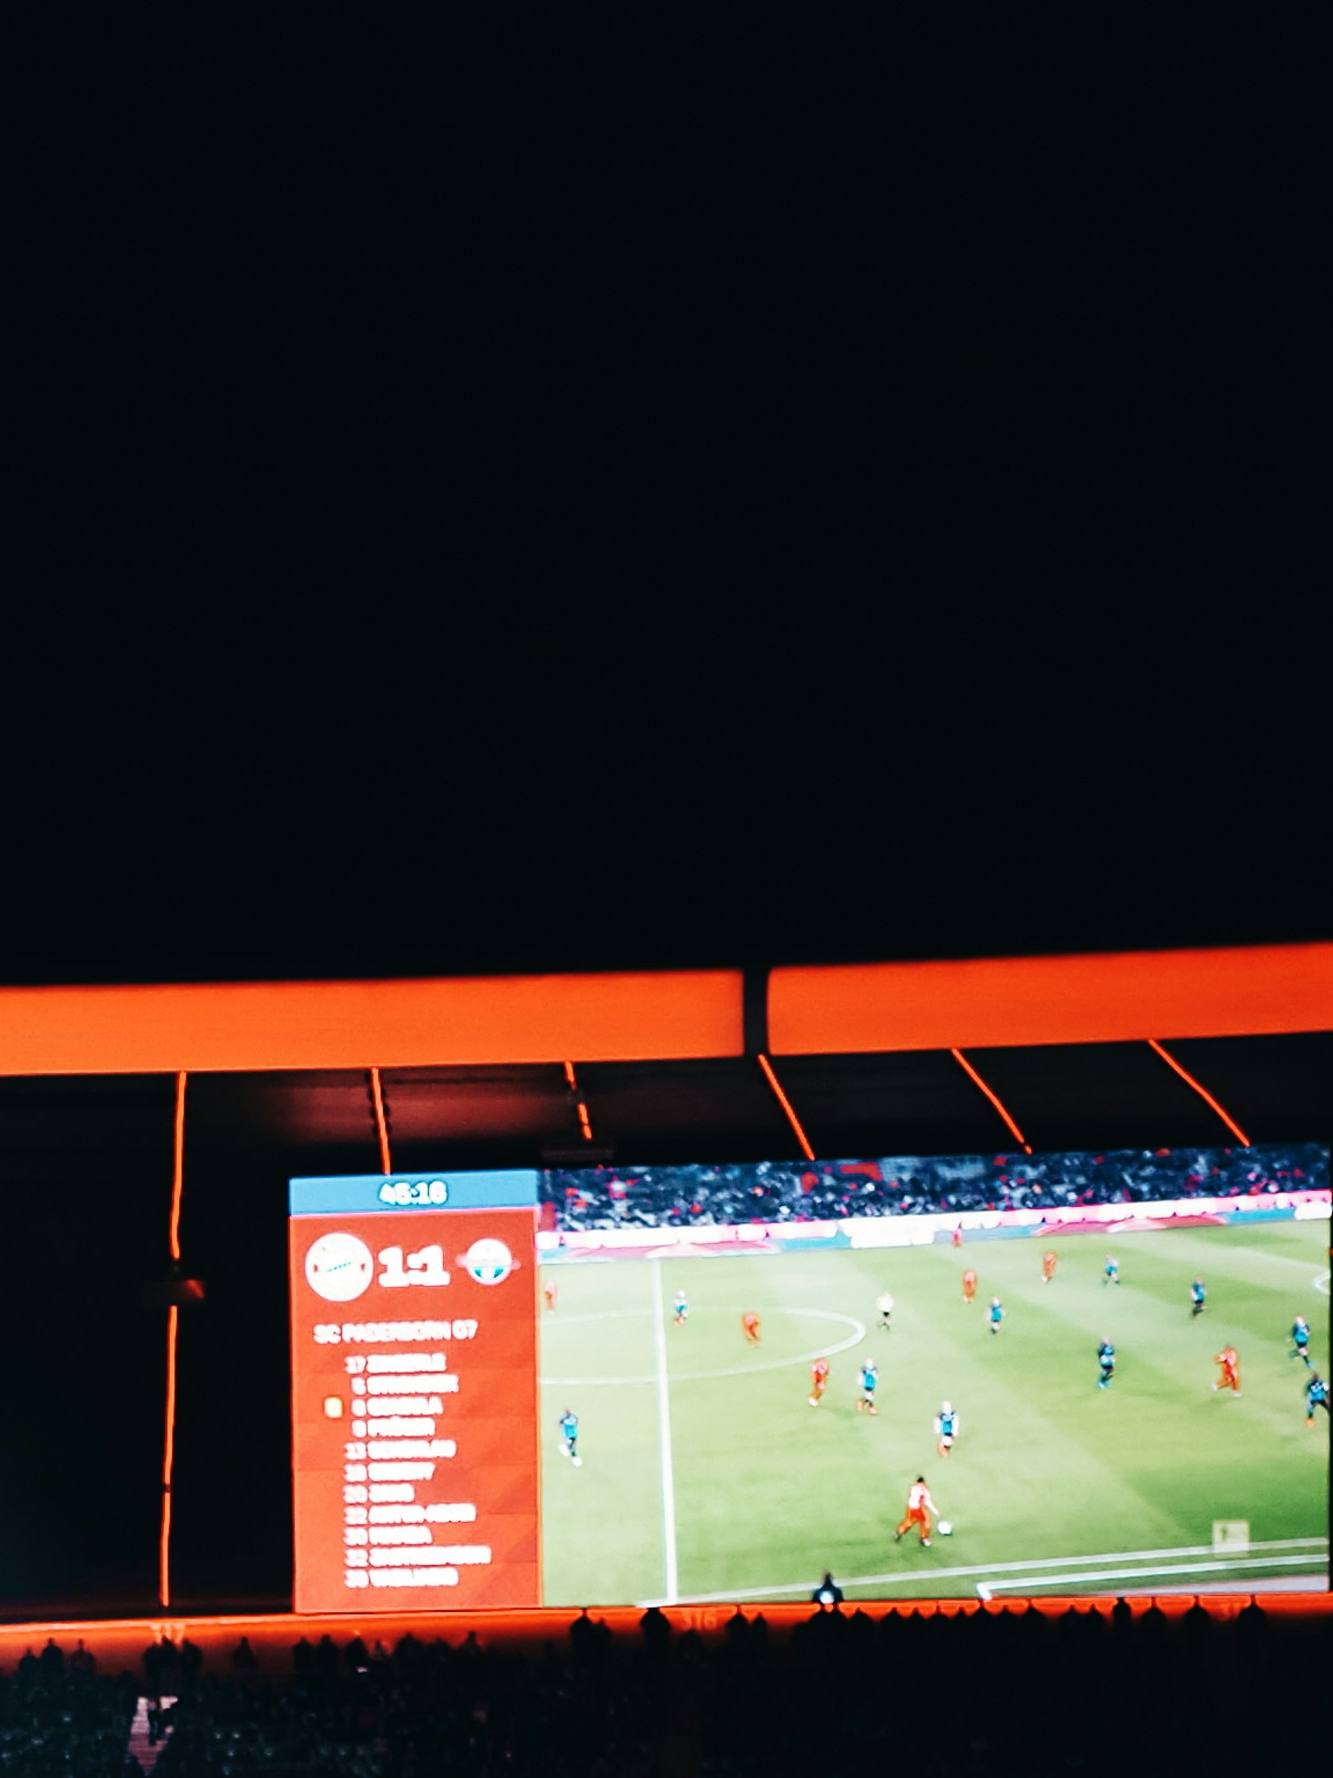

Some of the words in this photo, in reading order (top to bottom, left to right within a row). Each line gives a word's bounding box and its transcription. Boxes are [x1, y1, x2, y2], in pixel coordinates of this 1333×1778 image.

[378, 1245, 450, 1287] 1:1
[314, 1324, 341, 1344] SC
[342, 1321, 451, 1343] PADERBORN
